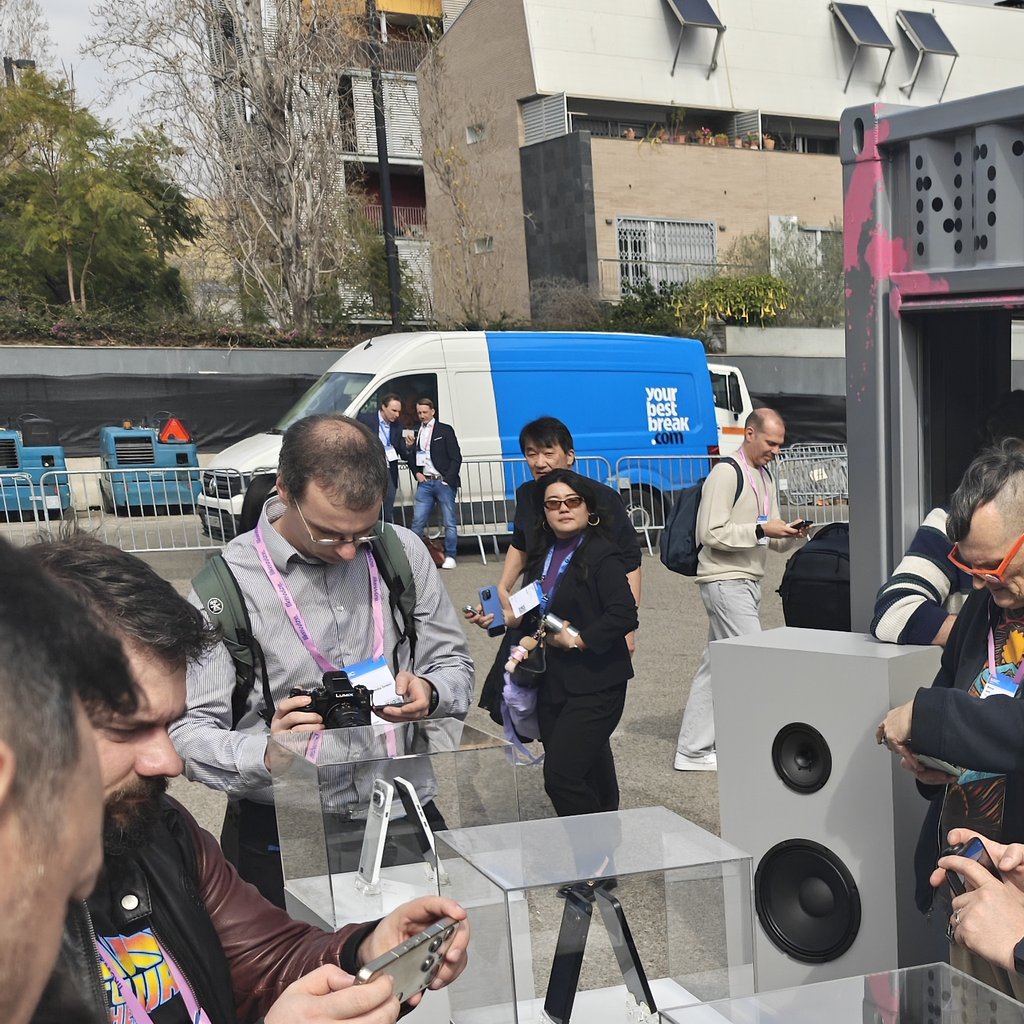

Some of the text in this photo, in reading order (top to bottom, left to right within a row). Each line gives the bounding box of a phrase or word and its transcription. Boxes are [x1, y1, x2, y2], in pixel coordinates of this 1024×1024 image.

[645, 387, 678, 402] your
[646, 401, 678, 417] best
[647, 417, 690, 432] break
[651, 431, 684, 446] .com
